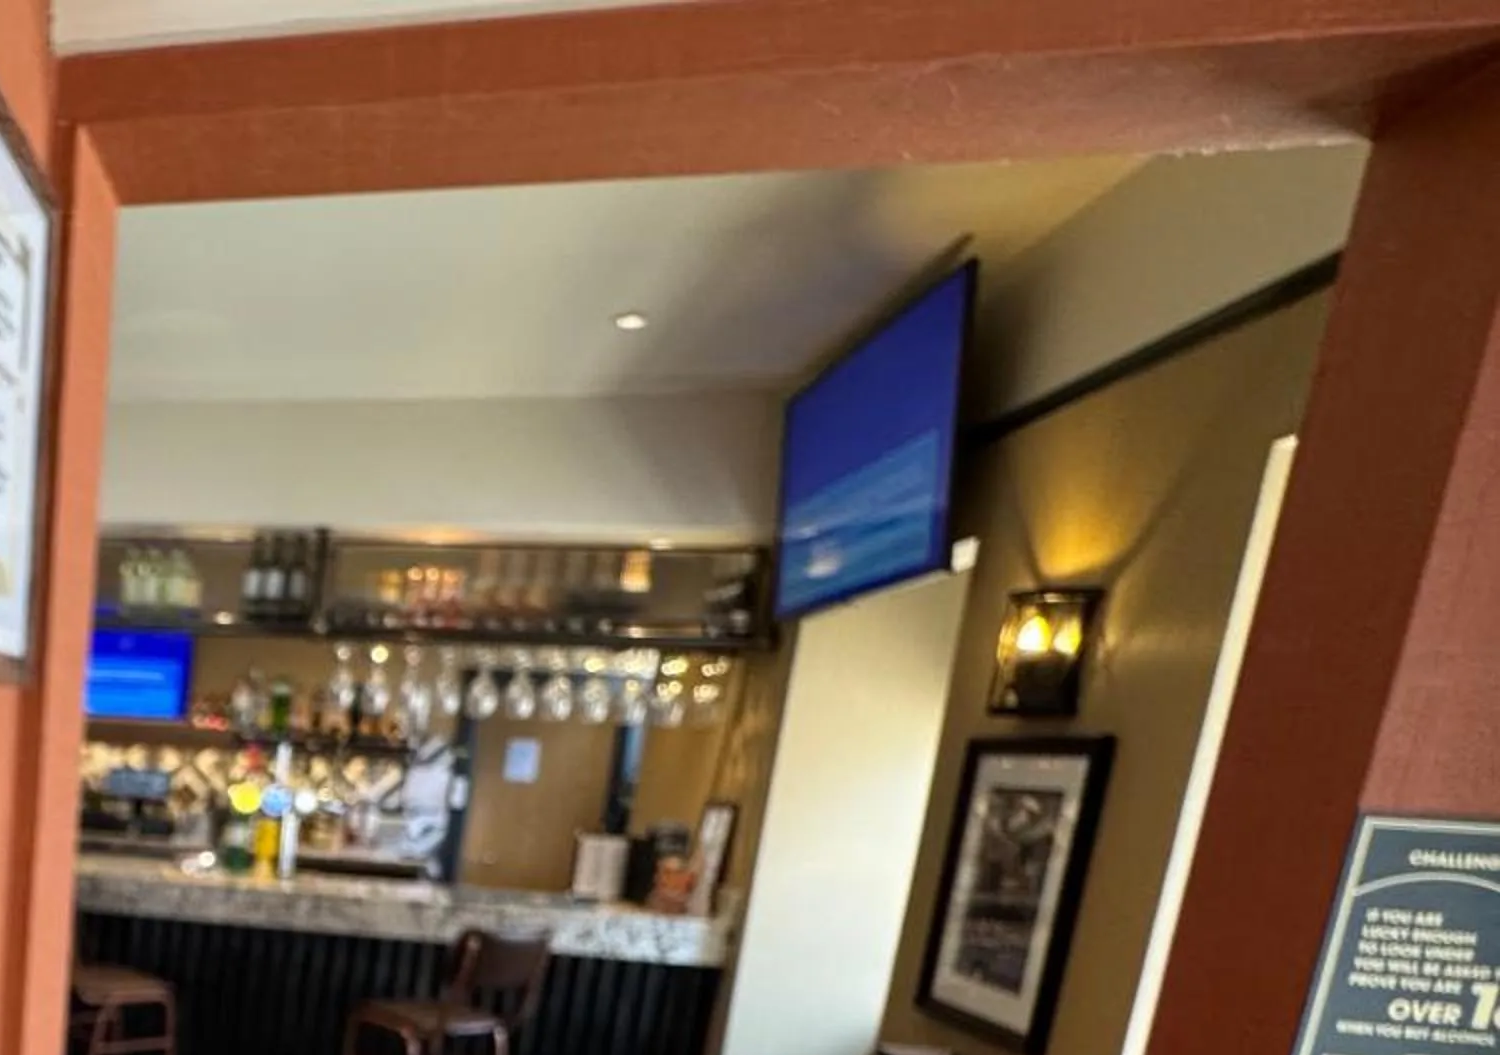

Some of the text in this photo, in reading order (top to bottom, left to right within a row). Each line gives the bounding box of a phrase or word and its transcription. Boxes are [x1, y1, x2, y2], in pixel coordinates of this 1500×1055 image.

[1382, 908, 1412, 925] YOU
[1414, 911, 1443, 927] ARE
[1387, 981, 1500, 1031] OVER 1
